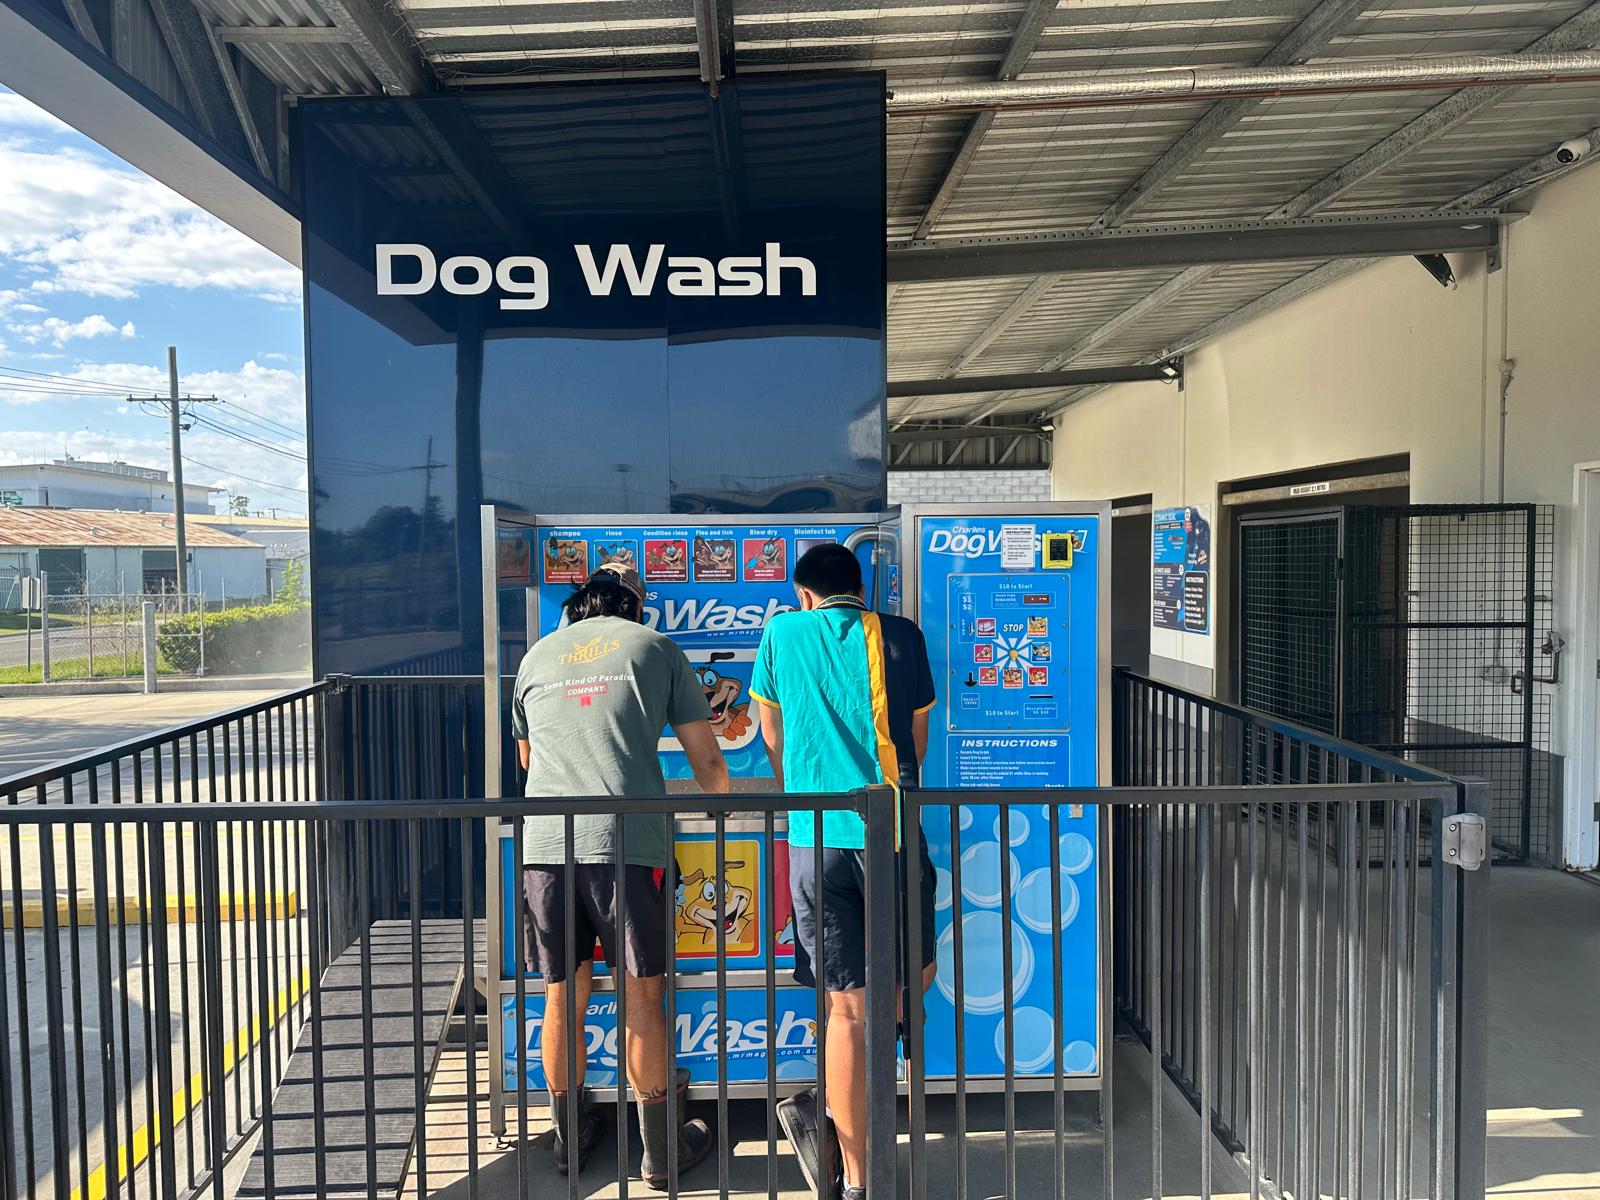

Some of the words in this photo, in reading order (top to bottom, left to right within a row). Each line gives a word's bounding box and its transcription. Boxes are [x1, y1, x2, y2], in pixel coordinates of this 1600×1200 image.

[376, 244, 549, 310] Dog
[574, 243, 817, 297] Wash
[766, 529, 778, 537] dry
[952, 526, 985, 534] Charlies
[1003, 624, 1024, 632] STOP
[543, 682, 563, 691] Some
[565, 677, 585, 687] Kind
[587, 676, 597, 684] Of
[599, 673, 635, 682] Paradise
[567, 686, 604, 696] COMPANY
[962, 739, 1058, 748] INSTRUCTIONS
